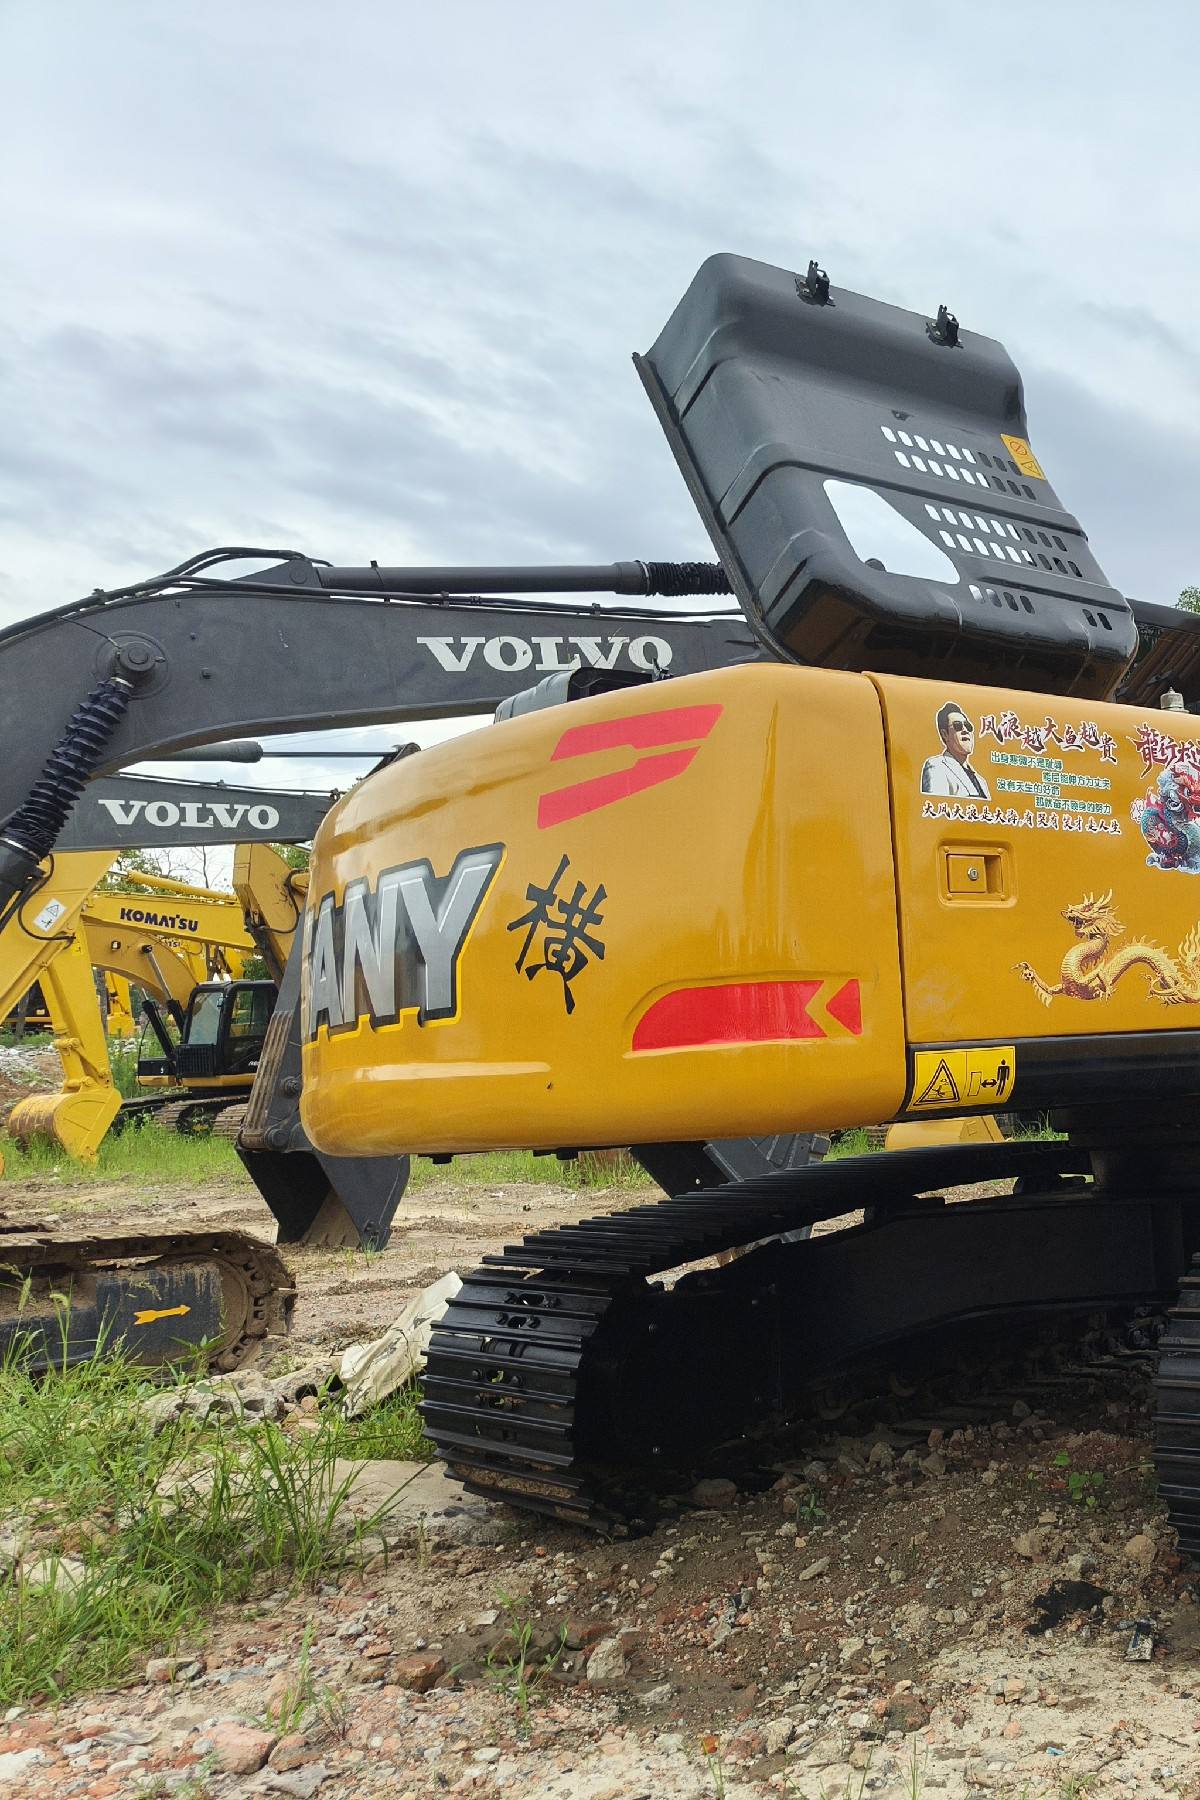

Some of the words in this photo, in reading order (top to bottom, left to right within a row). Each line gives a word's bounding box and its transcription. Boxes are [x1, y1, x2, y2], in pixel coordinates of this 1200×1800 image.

[417, 636, 673, 672] VOLVO
[979, 711, 1118, 764] 风浪越大鱼越贵
[99, 799, 279, 830] VOLVO
[120, 907, 199, 932] KOMATSU
[301, 842, 506, 1043] ANY
